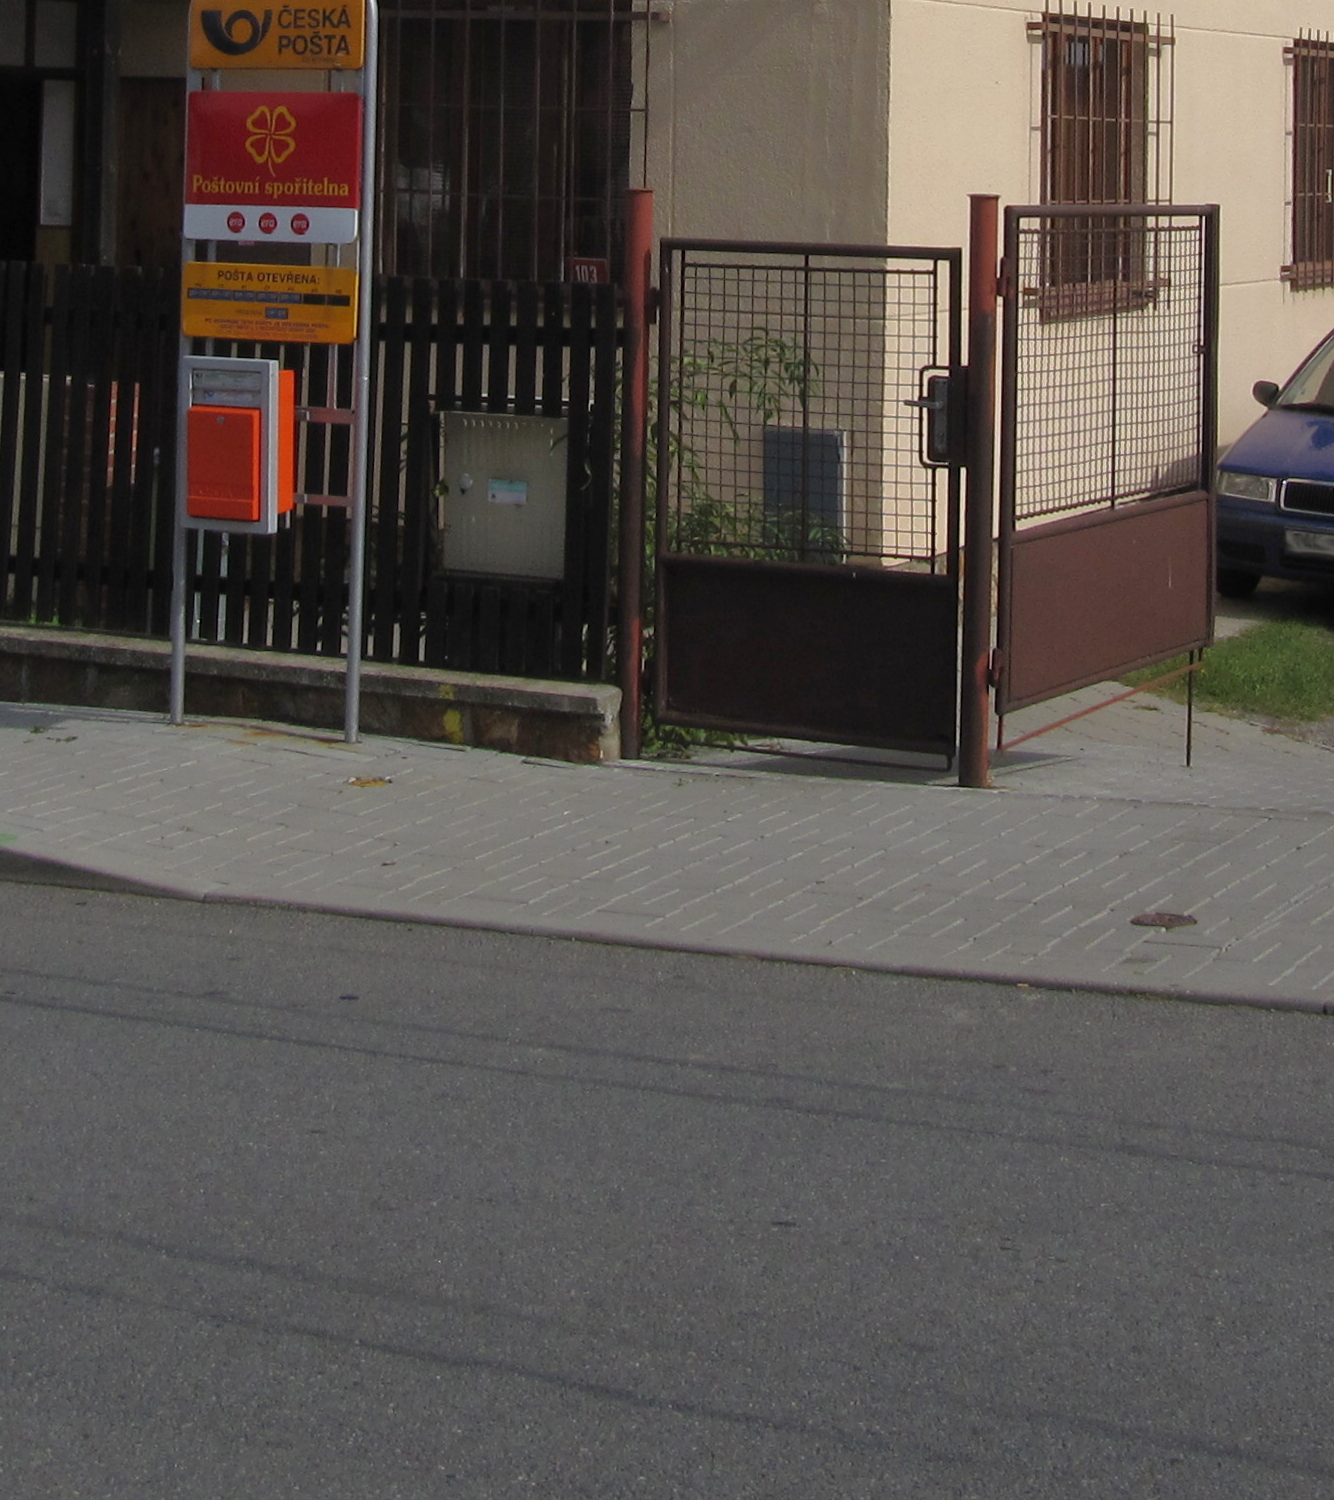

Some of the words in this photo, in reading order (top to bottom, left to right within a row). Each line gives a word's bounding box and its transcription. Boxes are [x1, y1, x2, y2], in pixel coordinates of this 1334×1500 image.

[277, 5, 351, 29] ČESKÁ
[278, 31, 351, 56] POŠTA
[192, 174, 260, 194] Poštovní
[264, 176, 349, 199] spořitelna
[218, 268, 254, 282] POŠTA
[575, 265, 598, 284] 103
